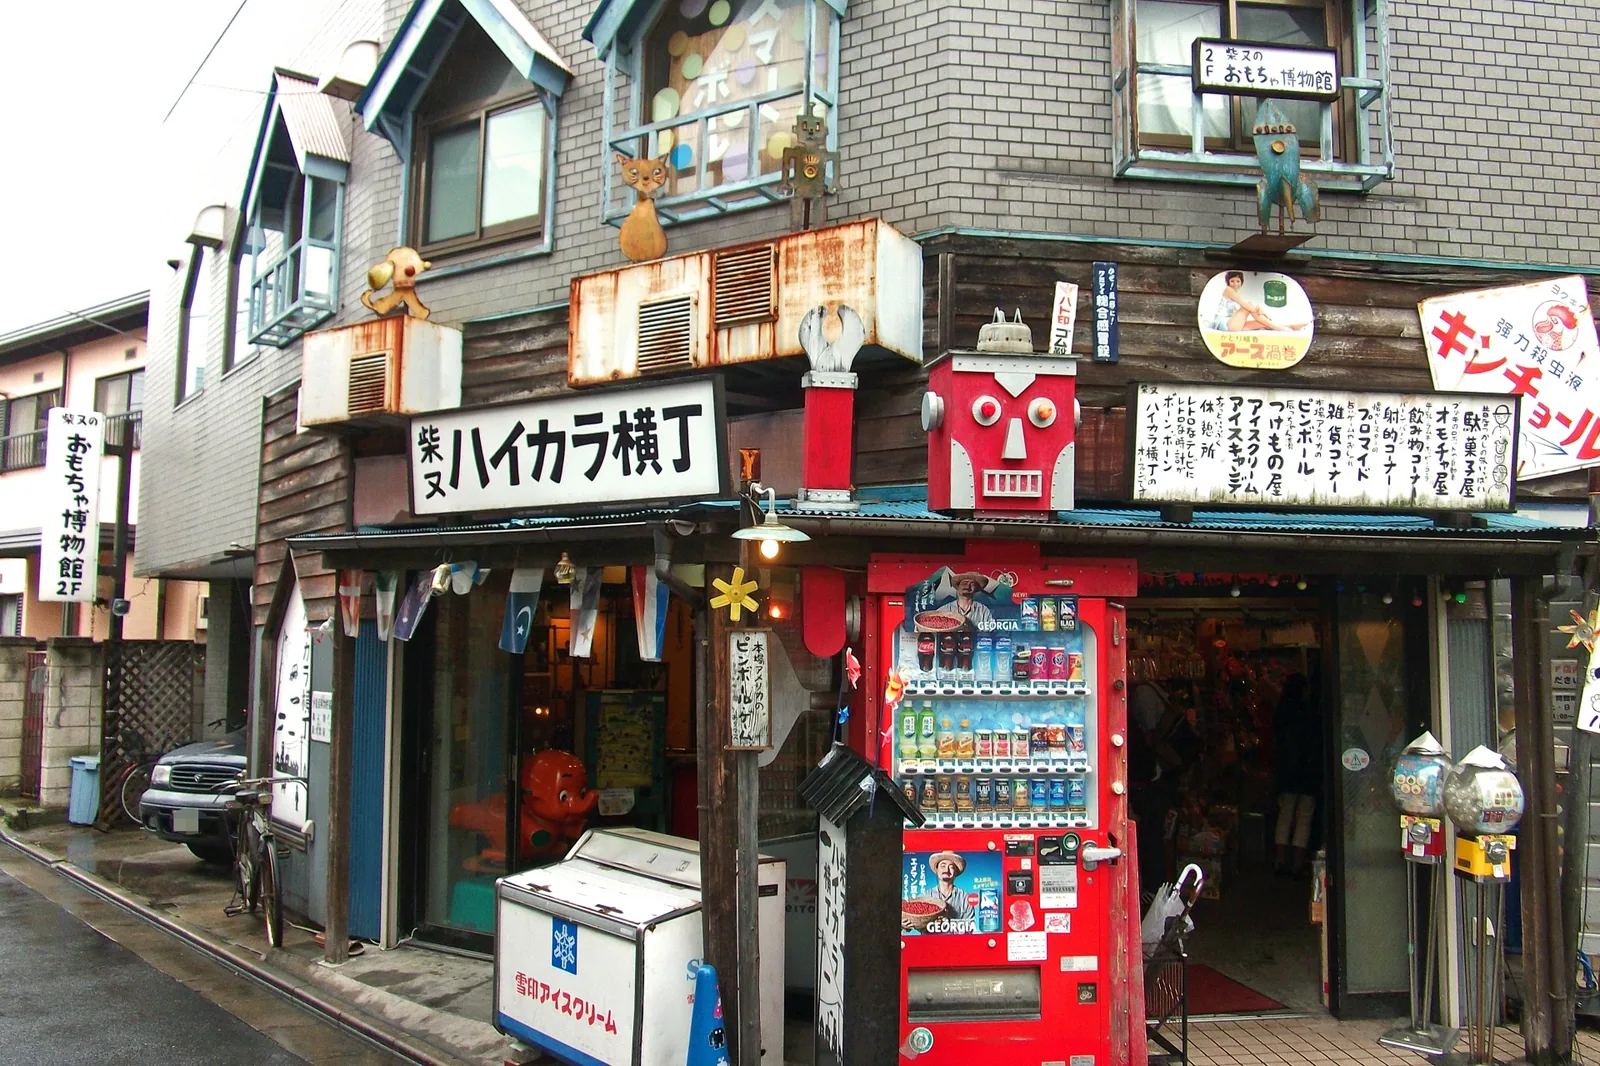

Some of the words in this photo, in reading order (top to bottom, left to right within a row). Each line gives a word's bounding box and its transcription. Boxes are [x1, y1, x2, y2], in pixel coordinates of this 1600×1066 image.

[1224, 64, 1333, 91] おもちゃ博物館
[1225, 46, 1263, 62] 柴又の
[1220, 342, 1297, 361] アース渦巻
[62, 413, 98, 427] 柴又の
[449, 403, 703, 490] ハイカラ横丁
[1146, 402, 1159, 485] ハイカラ横丁の
[1175, 396, 1186, 474] レトロな時計が
[1186, 396, 1198, 479] レトロなテレビに
[1200, 399, 1216, 459] 休憩所
[1244, 398, 1263, 495] アイスクリーム
[1266, 401, 1284, 497] つけもの屋
[1297, 398, 1315, 476] ピンボール
[1326, 403, 1344, 493] 雑貨コーナー
[1357, 408, 1373, 482] プロマイド
[1383, 406, 1399, 486] 射的コーナー
[1407, 406, 1425, 498] 飲み物コーナー
[1433, 406, 1450, 496] オモチャ屋
[1459, 411, 1481, 498] 駄菓子屋
[418, 423, 447, 500] 柴又
[58, 433, 92, 580] おもちゃ博物館
[56, 581, 83, 596] 2F
[977, 618, 1019, 631] GEORGIA
[752, 641, 765, 711] 本場アメリカの
[831, 842, 840, 978] ハイカラ
[926, 921, 977, 934] GEORGIA
[515, 970, 618, 1036] 雪印アイスクリーム
